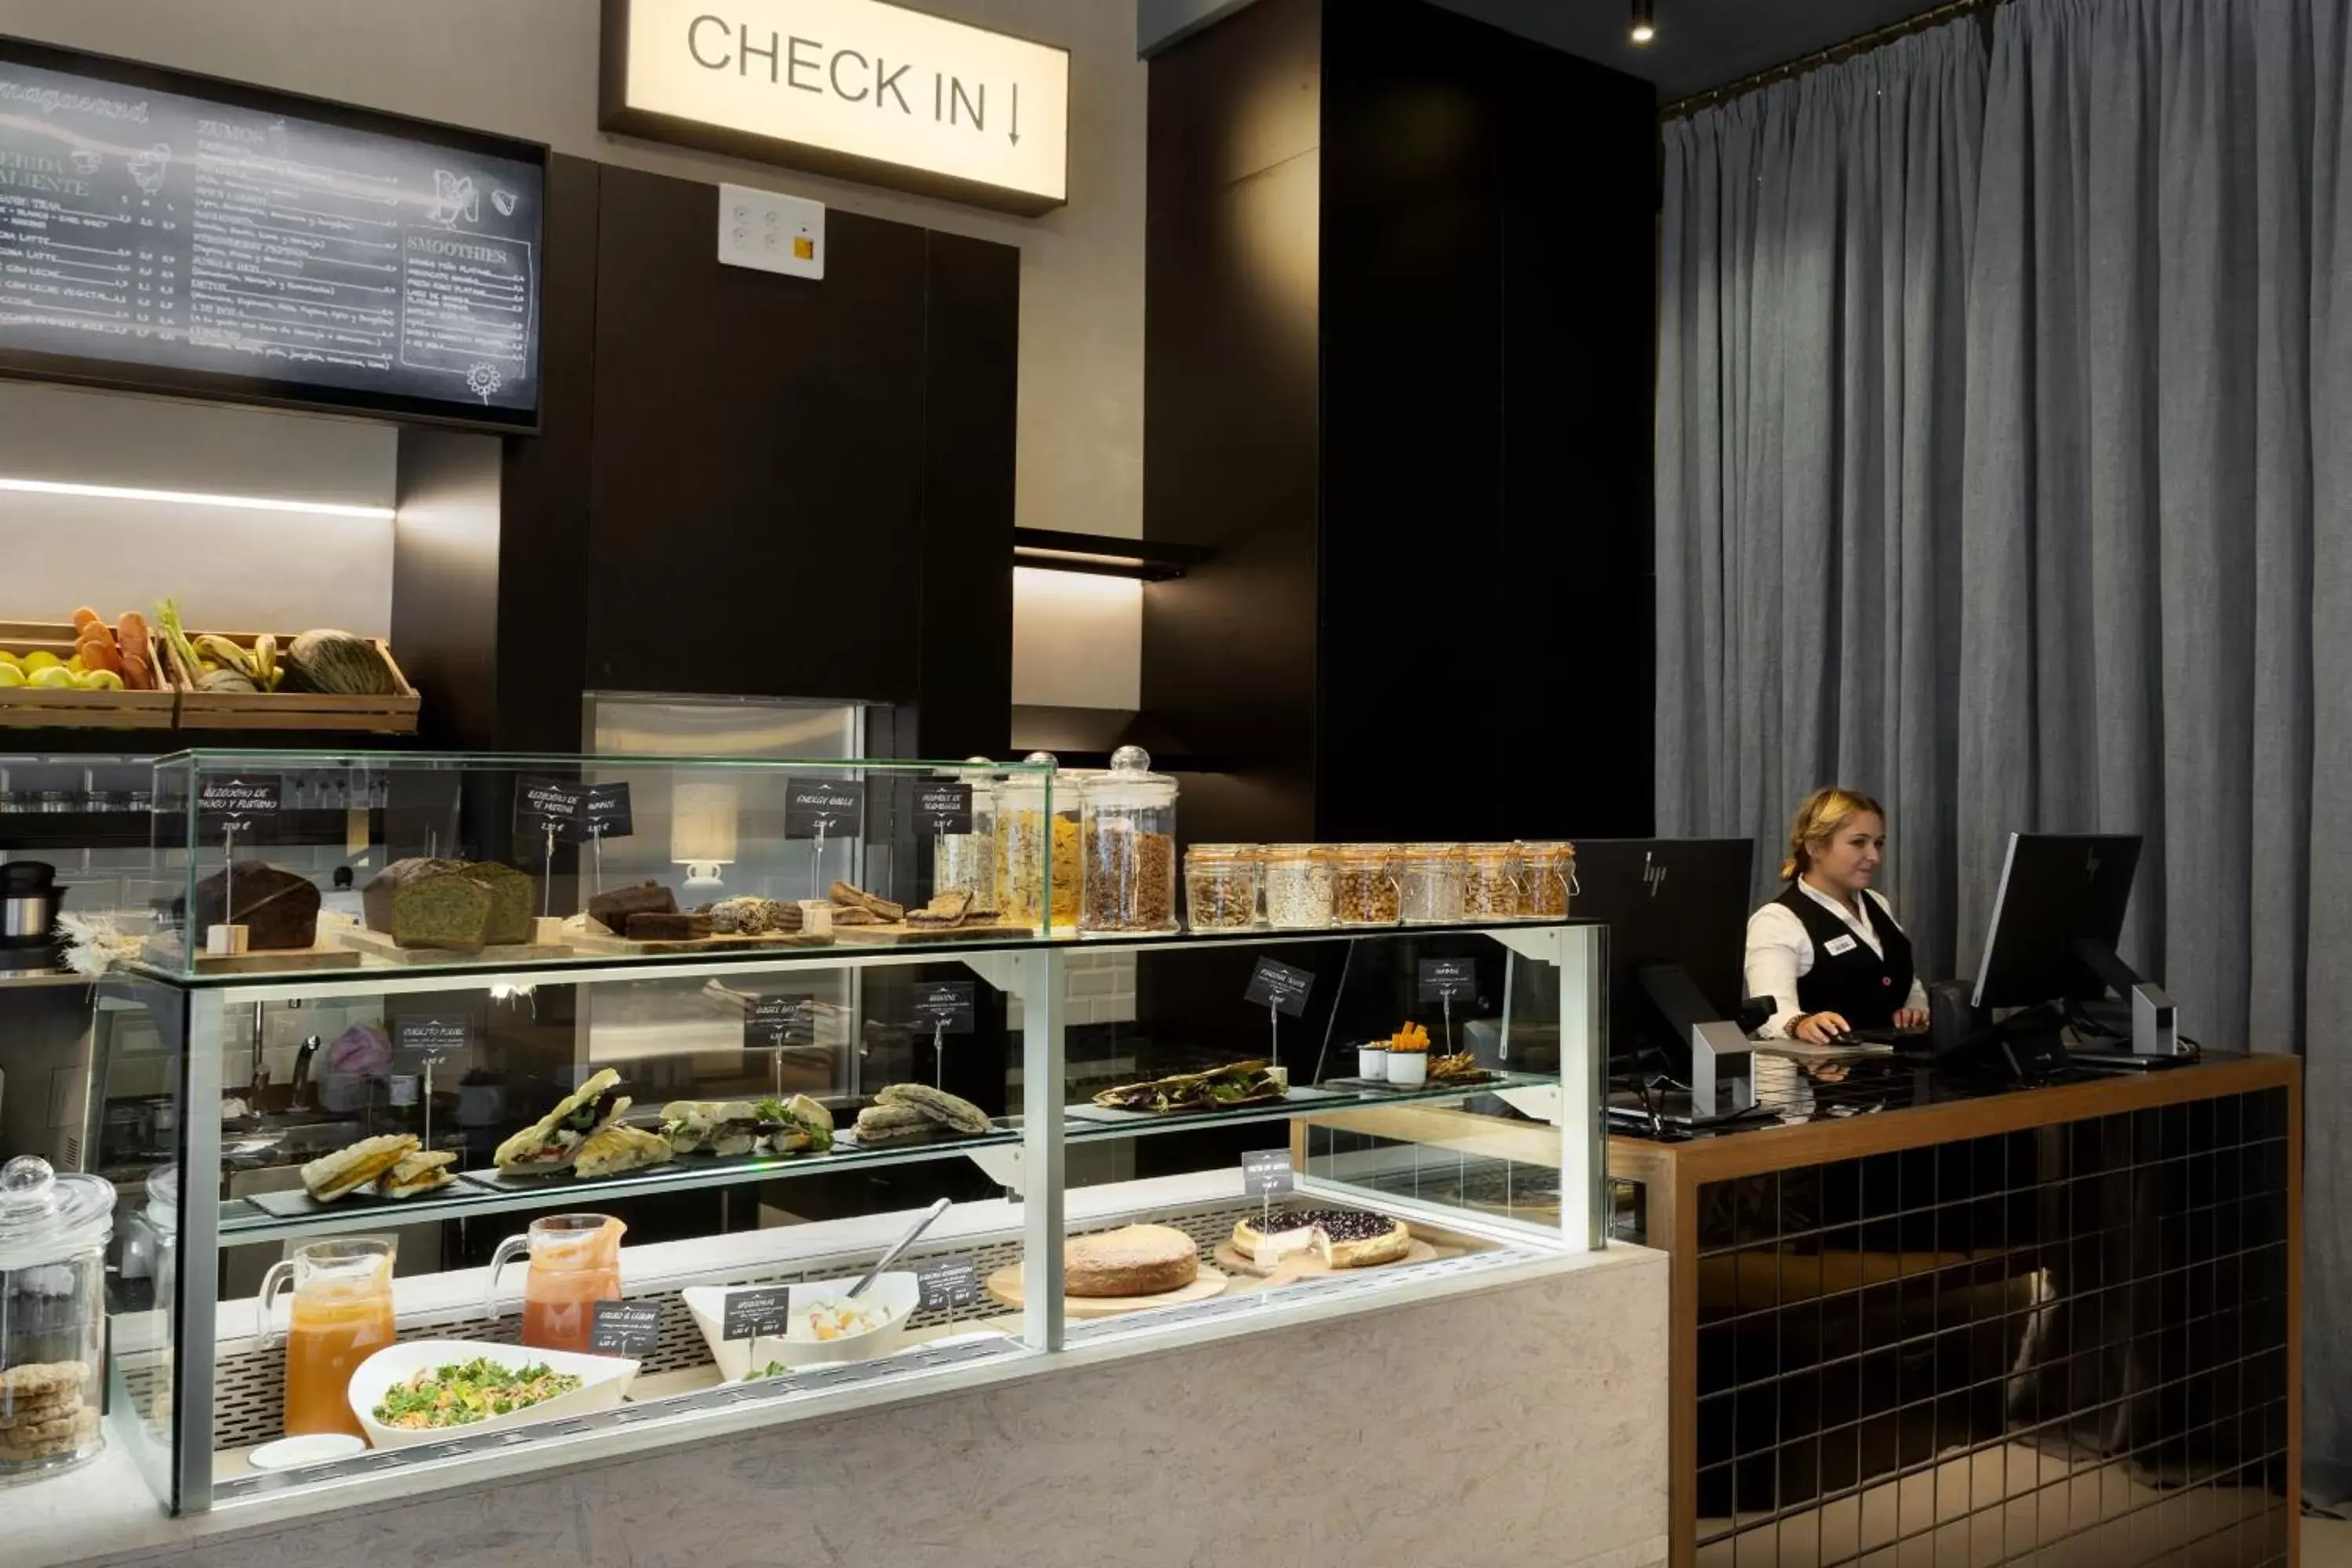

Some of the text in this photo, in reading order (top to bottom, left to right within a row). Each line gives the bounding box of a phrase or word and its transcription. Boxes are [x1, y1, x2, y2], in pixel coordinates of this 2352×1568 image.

[688, 14, 985, 132] CHECK IN
[407, 235, 507, 263] SMOOTHIES
